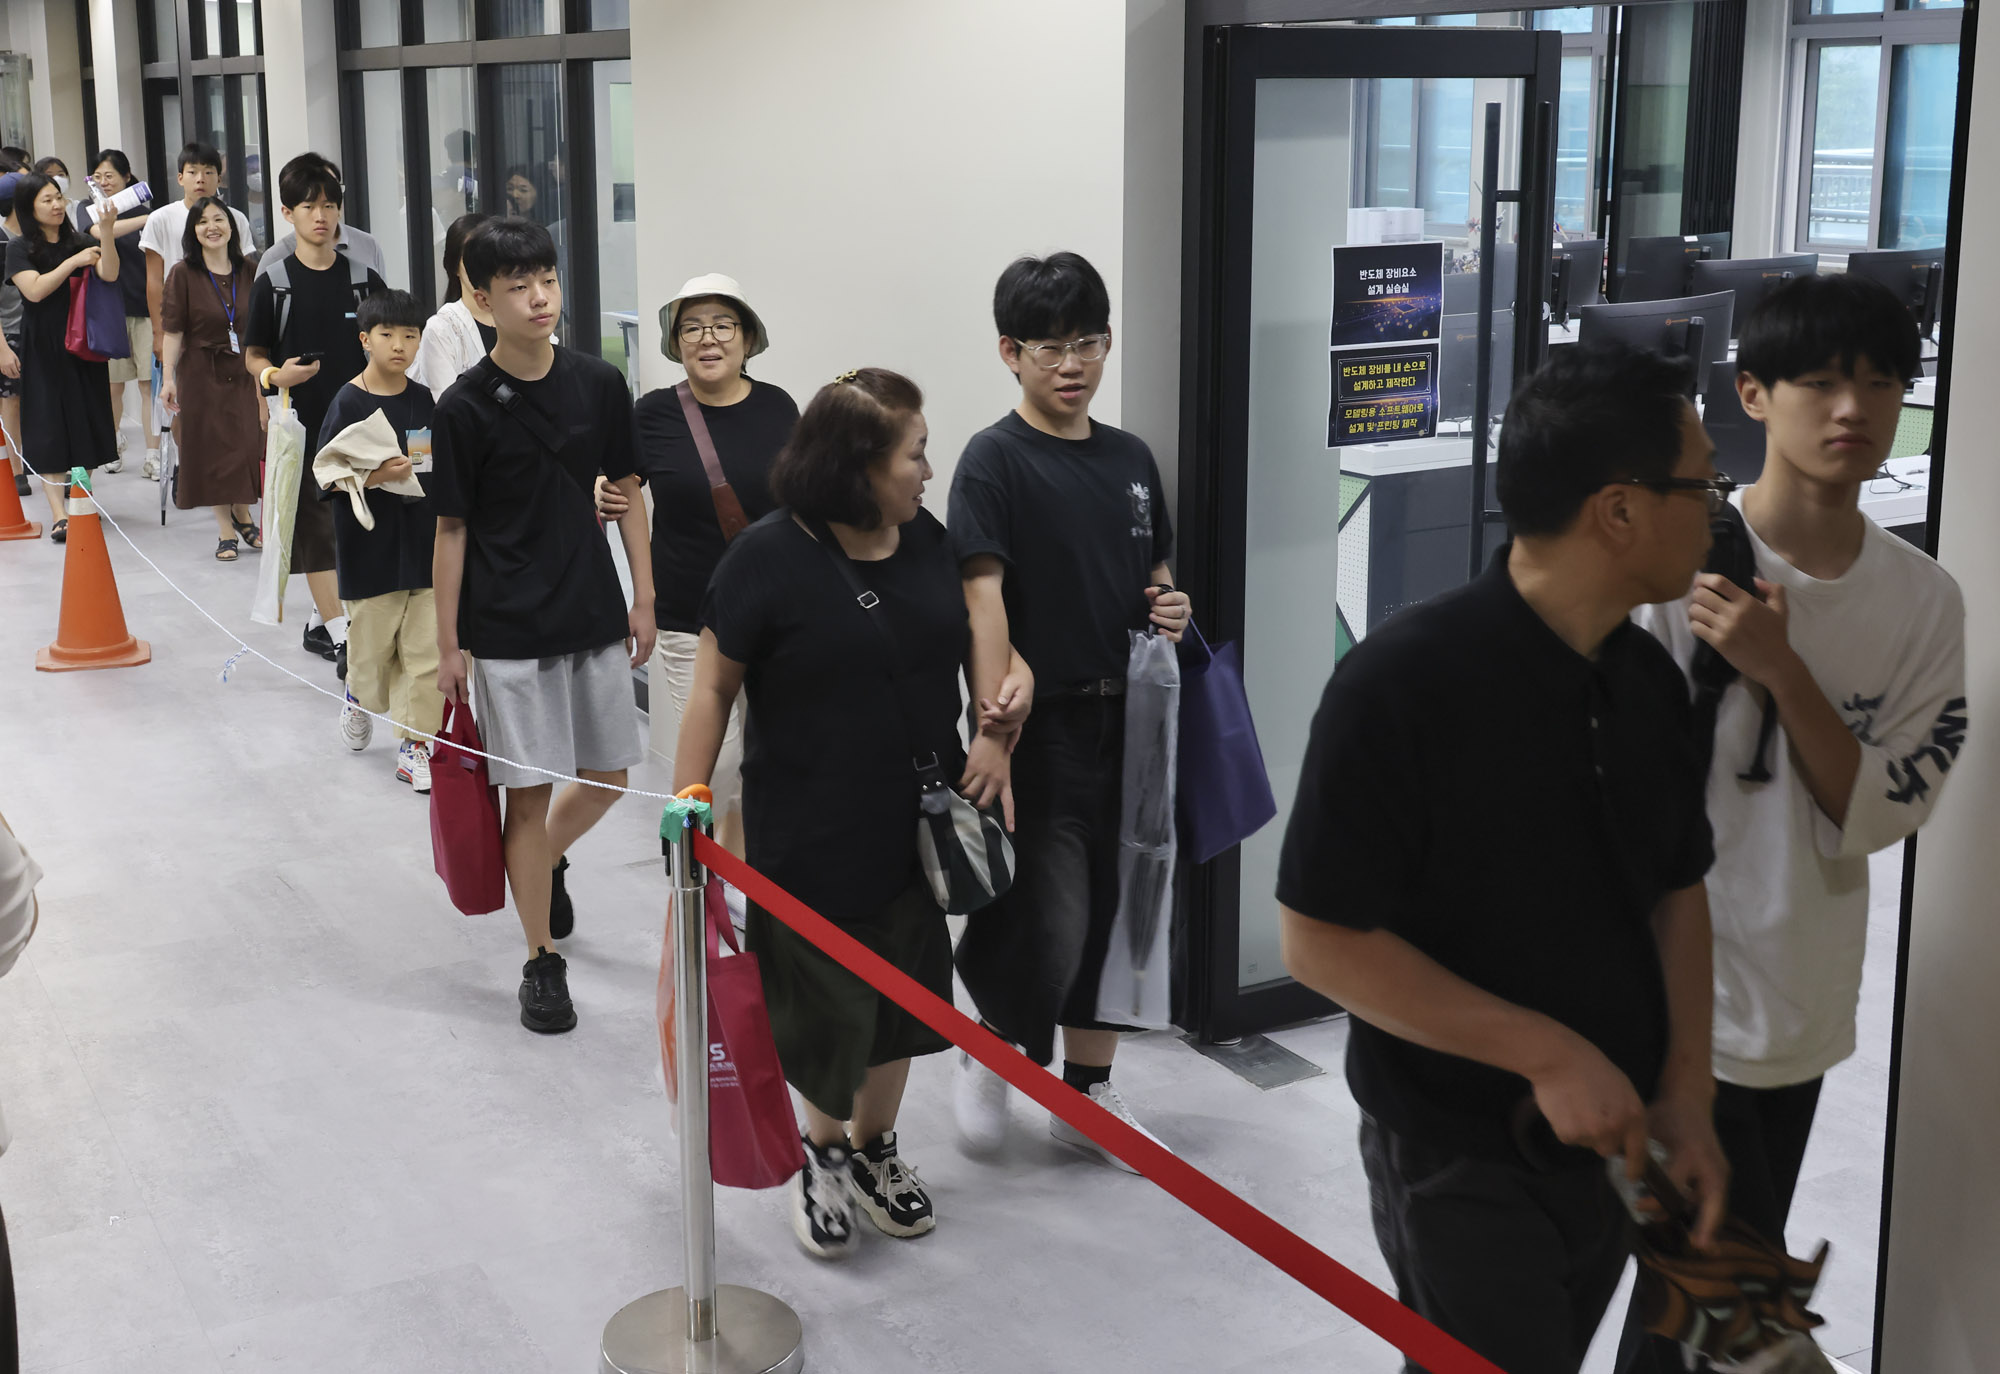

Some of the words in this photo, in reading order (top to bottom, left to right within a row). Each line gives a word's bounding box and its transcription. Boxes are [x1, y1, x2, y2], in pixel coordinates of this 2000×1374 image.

[1359, 268, 1384, 280] 반도체
[1385, 267, 1417, 279] 장비요소
[1367, 284, 1384, 295] 설계
[1386, 282, 1410, 294] 실습실
[1343, 365, 1367, 377] 반도체
[1368, 363, 1391, 375] 장비를
[1393, 362, 1402, 373] 내
[1403, 360, 1427, 372] 손으로
[1353, 379, 1384, 391] 설계하고
[1386, 376, 1416, 388] 제작한다
[1344, 407, 1376, 419] 모델링용
[1378, 403, 1424, 417] 소프트웨어로
[1348, 422, 1365, 434] 설계
[1401, 418, 1418, 429] 제작
